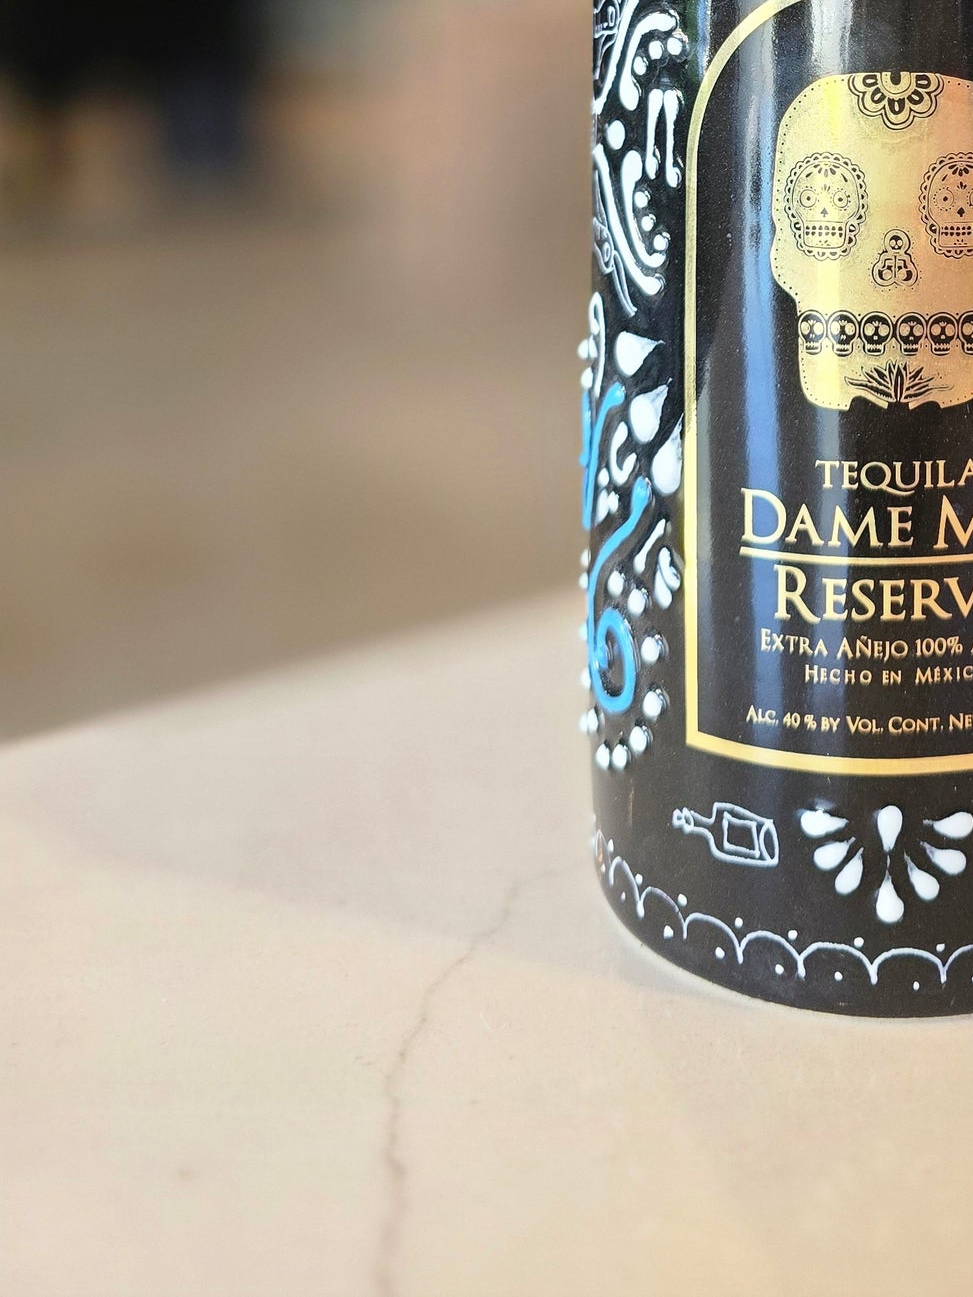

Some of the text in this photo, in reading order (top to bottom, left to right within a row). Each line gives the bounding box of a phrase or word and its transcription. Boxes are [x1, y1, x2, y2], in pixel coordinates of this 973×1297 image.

[739, 488, 914, 548] DAME
[760, 627, 828, 656] EXTRA
[836, 635, 909, 661] AÑEJO
[915, 635, 963, 655] 100%
[804, 664, 872, 685] HECHO
[881, 669, 902, 686] EN
[783, 713, 801, 729] 40
[821, 717, 839, 733] BY
